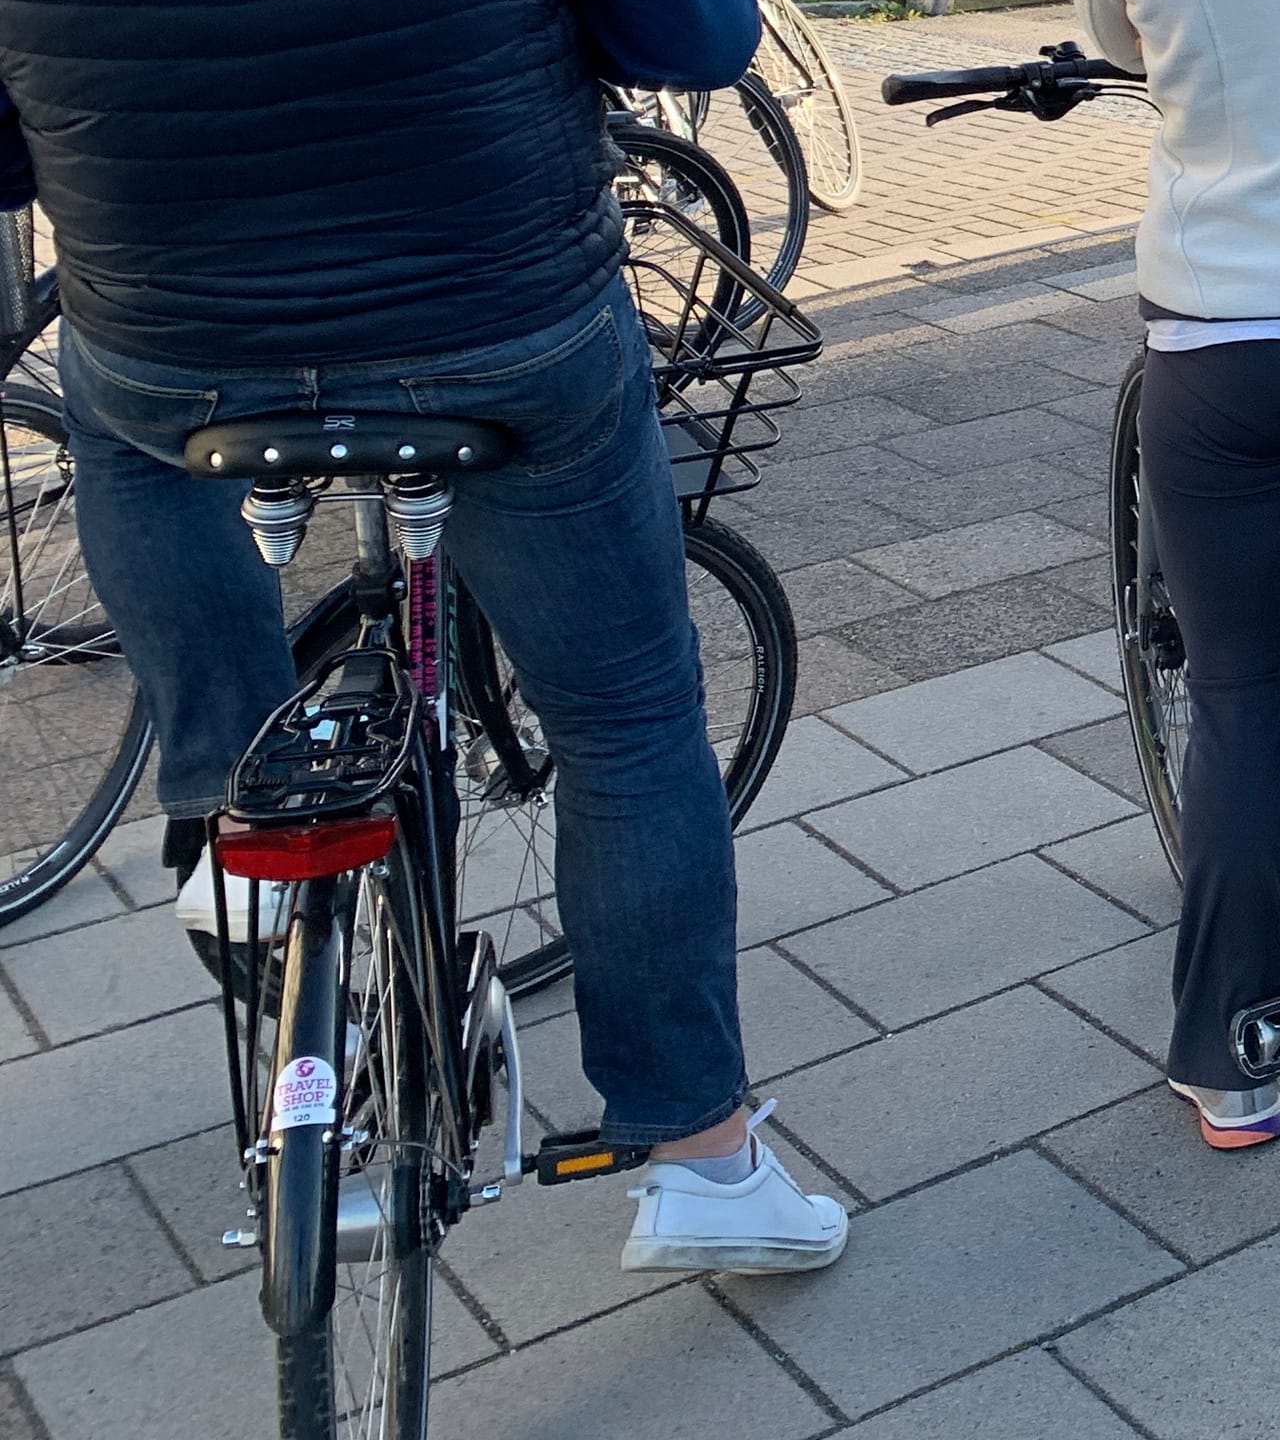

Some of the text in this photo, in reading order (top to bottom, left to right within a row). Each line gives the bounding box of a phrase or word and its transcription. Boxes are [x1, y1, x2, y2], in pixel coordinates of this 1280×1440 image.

[756, 646, 765, 693] RALEIGH
[278, 1078, 333, 1096] TRAVEL
[282, 1090, 325, 1107] SHOP
[293, 1113, 311, 1122] 120
